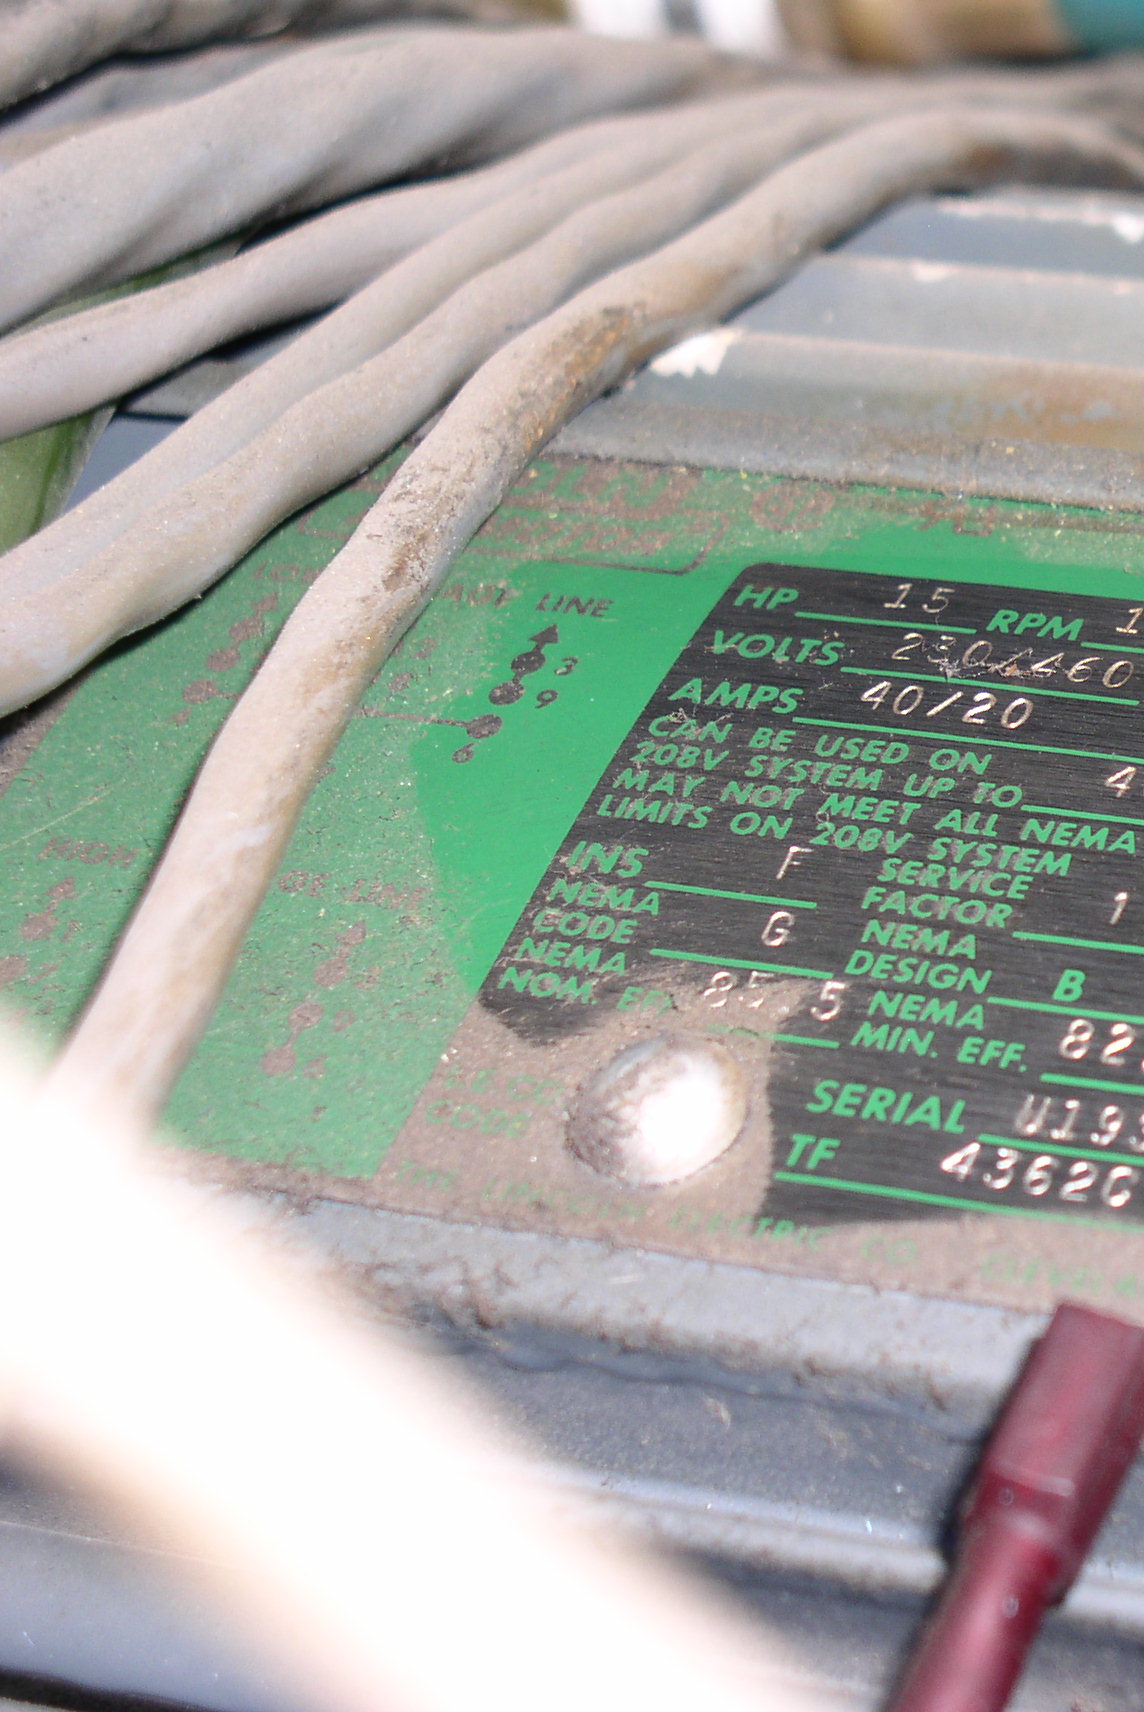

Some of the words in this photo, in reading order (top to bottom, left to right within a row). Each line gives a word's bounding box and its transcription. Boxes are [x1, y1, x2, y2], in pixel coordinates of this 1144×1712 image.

[535, 592, 615, 618] LINE
[735, 584, 798, 611] HP
[883, 583, 956, 613] 15
[987, 609, 1083, 641] RPM
[555, 656, 579, 675] 3
[712, 630, 845, 667] VOLTS
[534, 690, 559, 709] 9
[667, 677, 804, 716] AMPS
[860, 681, 1034, 729] 40/20
[648, 715, 733, 743] CAN
[748, 727, 797, 752] BE
[814, 734, 909, 764] USED
[929, 748, 992, 775] ON
[629, 741, 729, 771] 208V
[745, 755, 883, 791] SYSTEM
[902, 773, 956, 798] UP
[972, 781, 1023, 808] TO
[612, 768, 706, 798] MAY
[719, 781, 805, 810] NOT
[819, 792, 921, 825] MEET
[934, 809, 998, 837] ALL
[1020, 818, 1136, 854] NEMA
[597, 794, 713, 829] LIMITS
[729, 812, 793, 839] ON
[810, 822, 914, 854] 208V
[927, 837, 1073, 876] SYSTEM
[566, 840, 650, 878] INS
[776, 845, 814, 880] F
[877, 858, 1034, 900] SERVICE
[550, 878, 661, 915] NEMA
[860, 886, 1014, 929] FACTOR
[535, 908, 639, 944] CODE
[761, 911, 795, 948] G
[860, 918, 977, 960] NEMA
[518, 937, 628, 976] NEMA
[843, 949, 993, 994] DESIGN
[1052, 969, 1086, 1002] B
[499, 966, 599, 1006] NOM.
[867, 989, 986, 1031] NEMA
[850, 1020, 938, 1059] MIN.
[956, 1036, 1028, 1072] EFF.
[805, 1079, 967, 1135] SERIAL
[785, 1133, 841, 1170] TF
